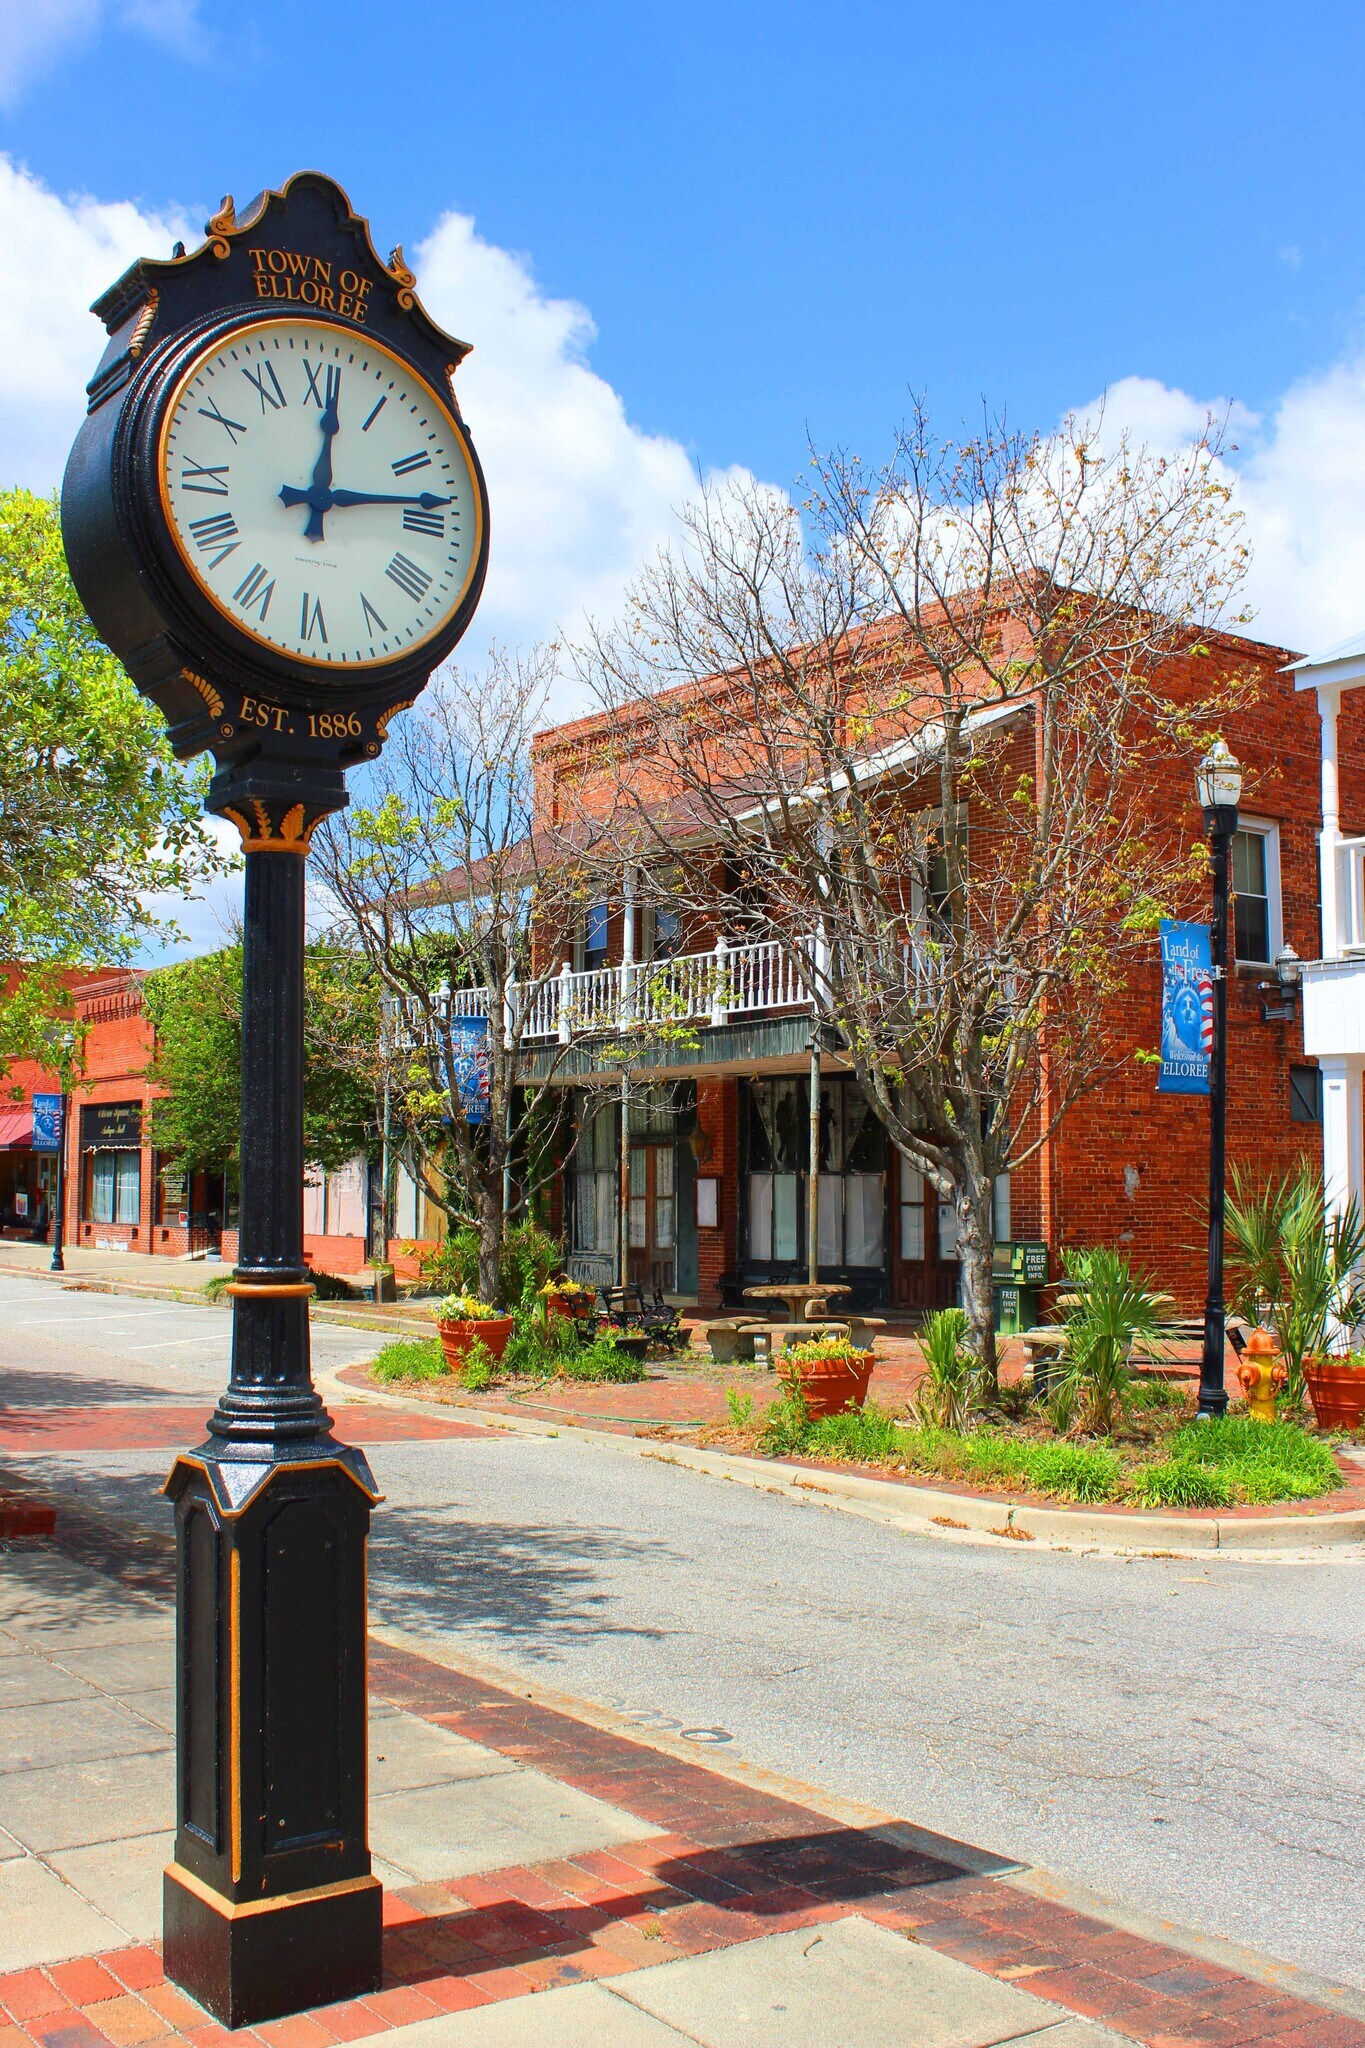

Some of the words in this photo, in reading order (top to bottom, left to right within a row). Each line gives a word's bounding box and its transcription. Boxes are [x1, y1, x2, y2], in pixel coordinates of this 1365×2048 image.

[248, 249, 333, 284] TOWN
[340, 270, 373, 300] OF
[254, 275, 368, 324] ELLOREE
[241, 360, 288, 415] XI
[197, 396, 247, 445] X
[181, 454, 230, 496] IX
[391, 450, 432, 477] II
[188, 512, 243, 571] VIII
[403, 508, 445, 539] III
[232, 562, 277, 622] VII
[384, 551, 434, 604] IIII
[300, 591, 329, 644] VI
[359, 591, 389, 638] V
[239, 695, 295, 735] EST.
[307, 711, 362, 738] 1886
[1162, 935, 1190, 962] Land
[1189, 944, 1200, 960] of
[1168, 961, 1185, 979] the
[1183, 958, 1210, 984] Free
[1163, 1062, 1208, 1077] ELLOREE
[1169, 1050, 1197, 1062] Welcome
[1026, 1255, 1046, 1264] FREE
[1002, 1291, 1017, 1299] FREE
